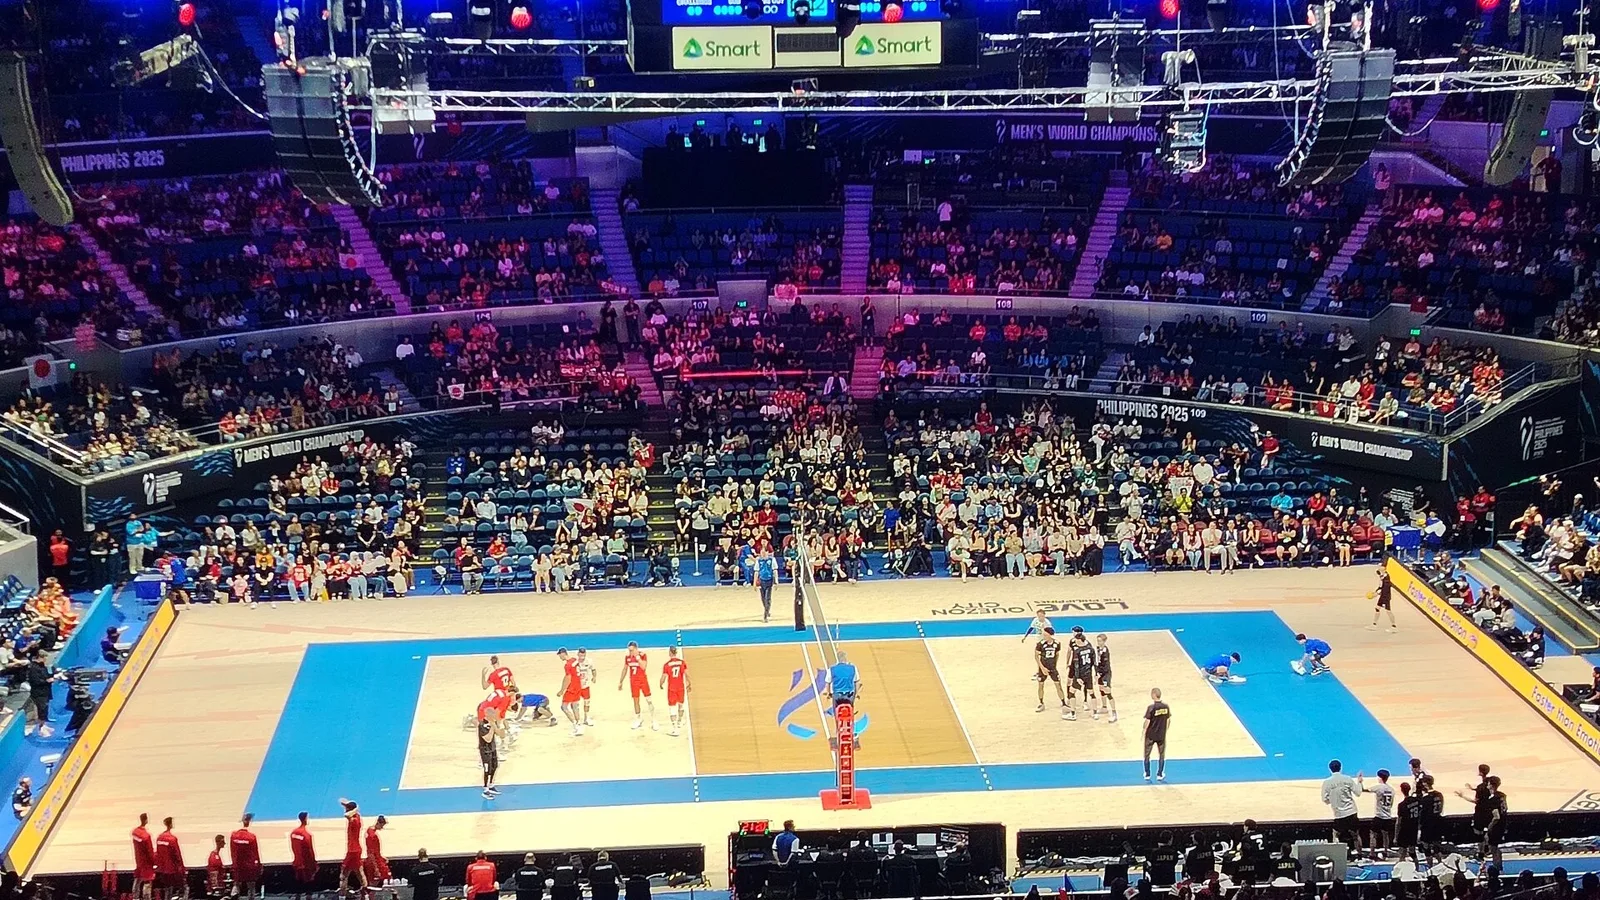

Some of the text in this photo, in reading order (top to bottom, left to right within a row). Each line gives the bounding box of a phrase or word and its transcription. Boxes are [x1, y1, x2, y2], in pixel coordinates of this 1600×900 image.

[705, 41, 761, 57] Smart
[877, 35, 932, 54] Smart
[1010, 124, 1044, 140] MEN'S
[1048, 126, 1088, 140] WORLD
[60, 150, 165, 172] PHILIPPINES 2025
[693, 301, 707, 309] 107
[997, 300, 1011, 308] 108
[1190, 408, 1206, 418] 109
[244, 445, 270, 463] MEN'S
[271, 440, 301, 457] WORLD
[1340, 438, 1364, 453] WORLD
[952, 601, 1000, 609] CITY
[1036, 601, 1129, 612] LOVE
[631, 666, 638, 675] 7
[1532, 686, 1555, 713] Faster
[1556, 706, 1574, 730] than
[1277, 861, 1296, 869] JAPAN
